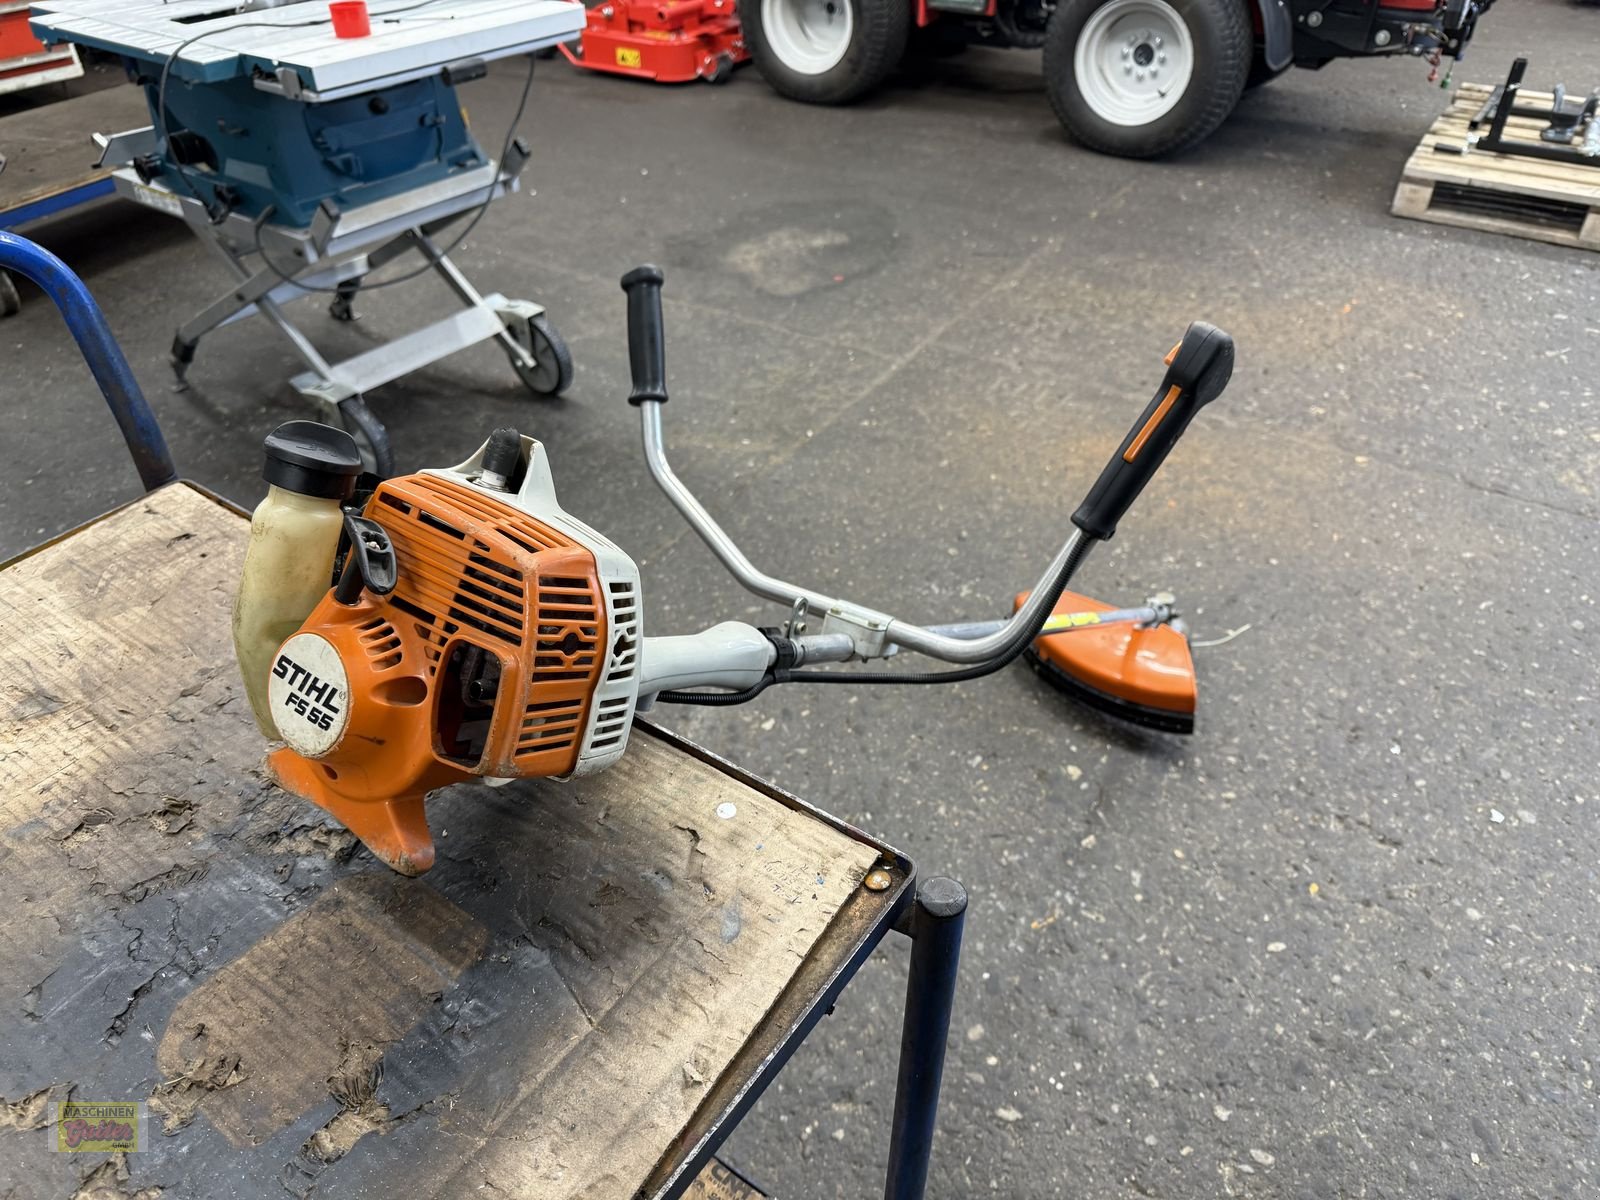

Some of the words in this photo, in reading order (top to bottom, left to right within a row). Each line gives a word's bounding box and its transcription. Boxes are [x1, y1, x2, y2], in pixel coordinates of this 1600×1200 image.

[272, 655, 340, 714] STIHL
[284, 692, 310, 716] FS
[307, 706, 334, 731] 55
